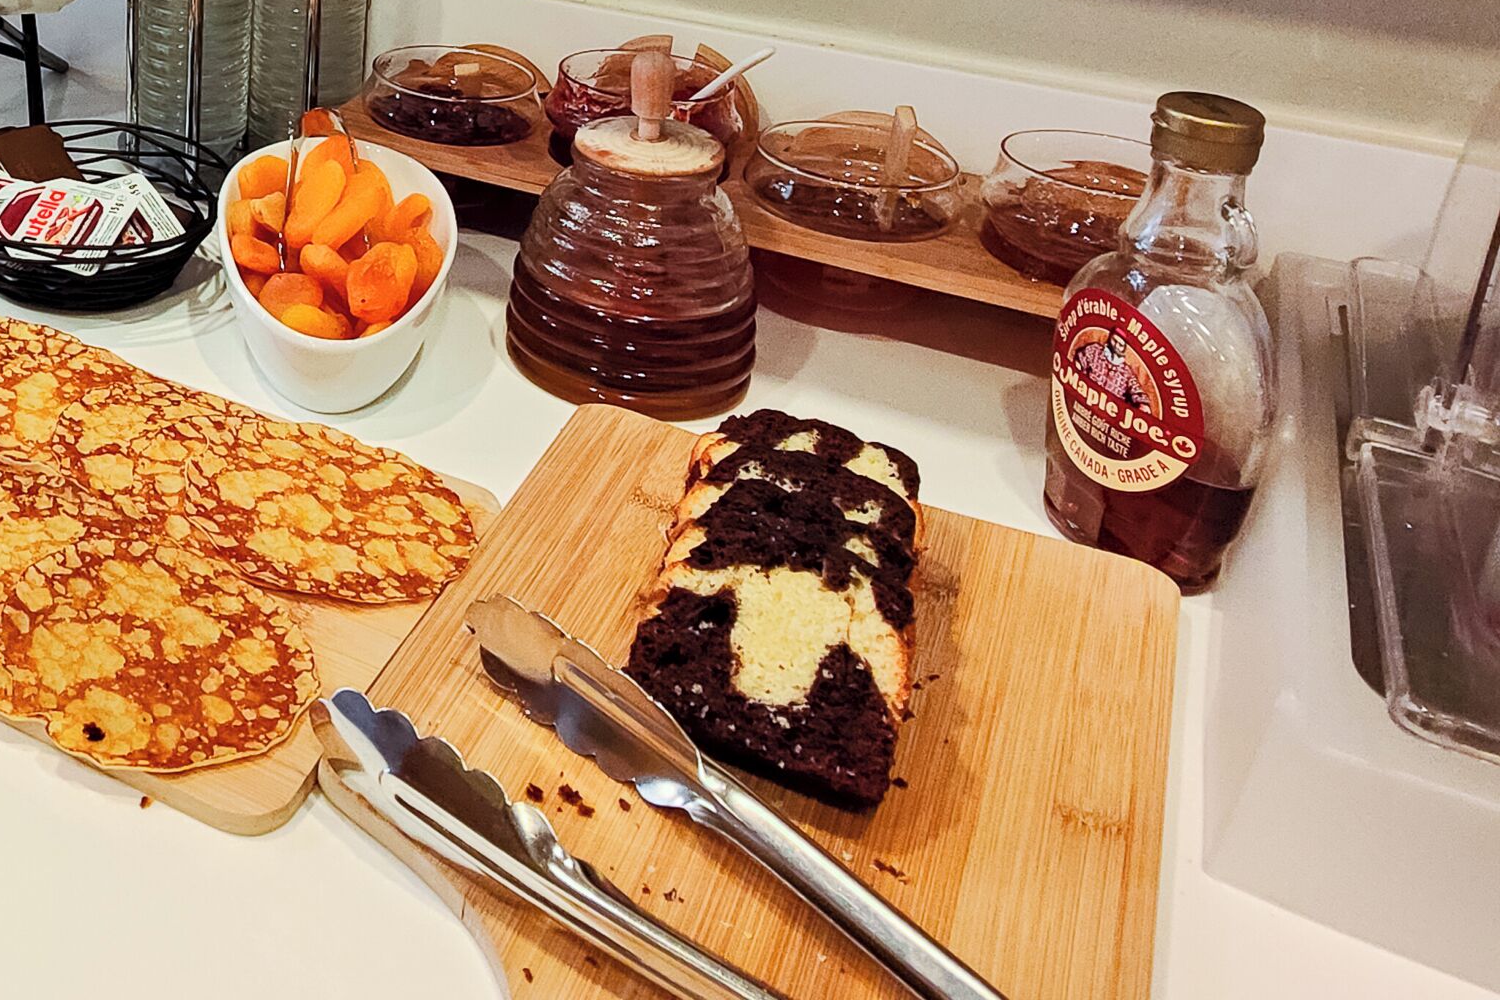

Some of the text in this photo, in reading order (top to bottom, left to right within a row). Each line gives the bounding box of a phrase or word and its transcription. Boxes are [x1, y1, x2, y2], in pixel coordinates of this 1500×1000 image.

[21, 188, 67, 243] nutella
[1058, 310, 1078, 342] Sirop
[1076, 298, 1118, 321] d'érable
[1126, 317, 1169, 366] Maple
[1163, 368, 1190, 418] syrup
[1054, 390, 1072, 440] ORIGINE
[1070, 440, 1109, 479] CANADA
[1117, 464, 1159, 484] GRADE
[1156, 459, 1171, 474] A
[1060, 363, 1169, 447] Maple Joe
[1090, 426, 1107, 444] RICH
[1107, 437, 1129, 459] TASTE
